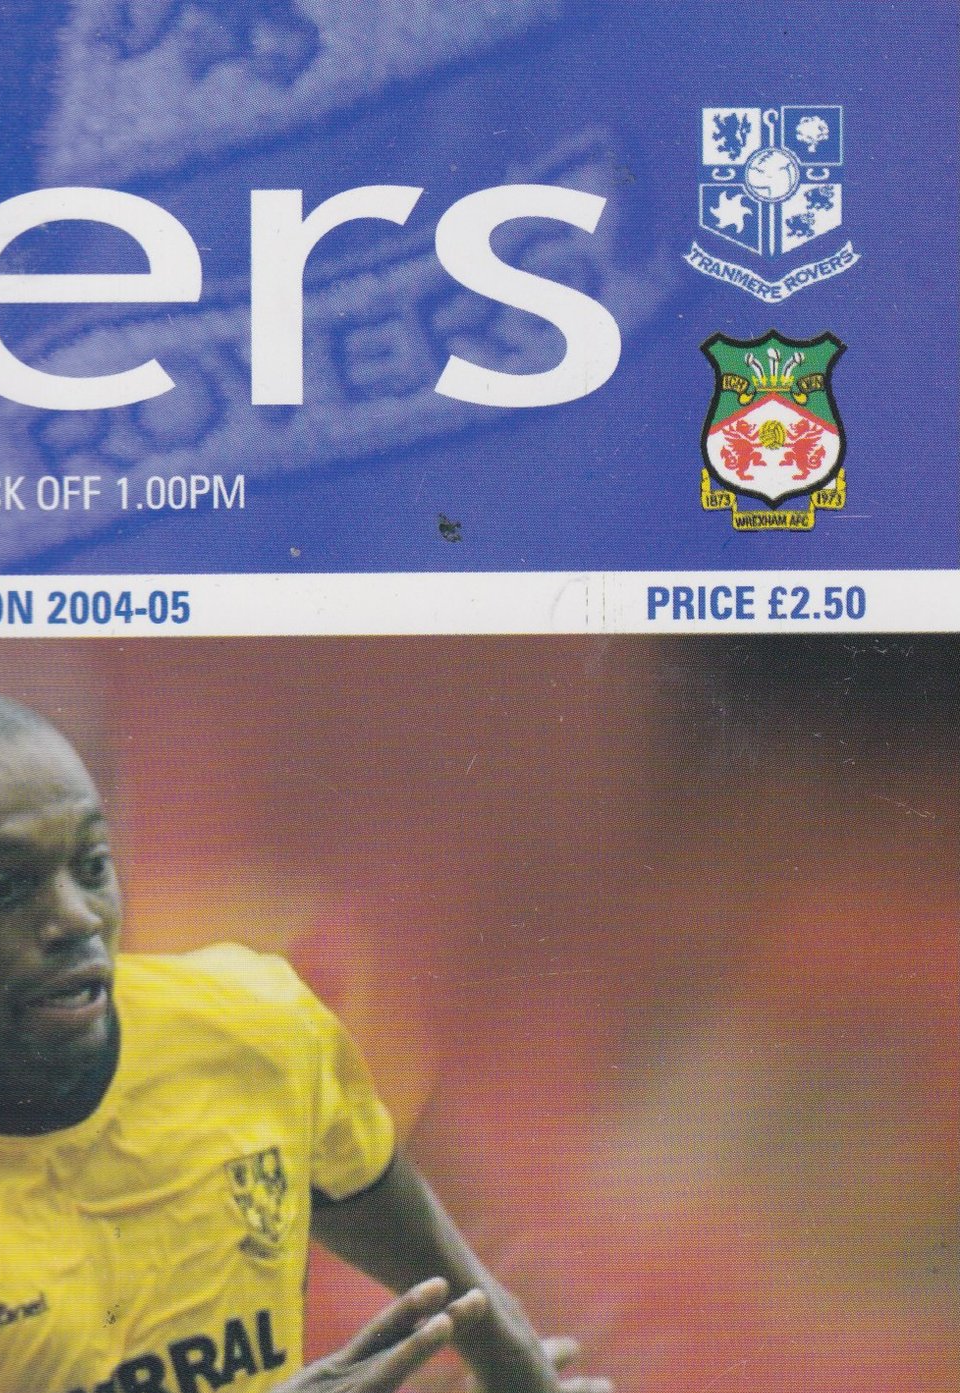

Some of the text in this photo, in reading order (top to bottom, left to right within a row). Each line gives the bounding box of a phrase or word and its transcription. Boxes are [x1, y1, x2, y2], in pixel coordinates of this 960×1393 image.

[690, 250, 854, 299] TRANMERE ROVERS
[37, 475, 102, 511] OFF
[116, 474, 246, 511] 1.00PM
[735, 514, 787, 527] WREXHAM
[47, 590, 191, 626] 2004-05
[646, 585, 867, 621] PRICE £2.50
